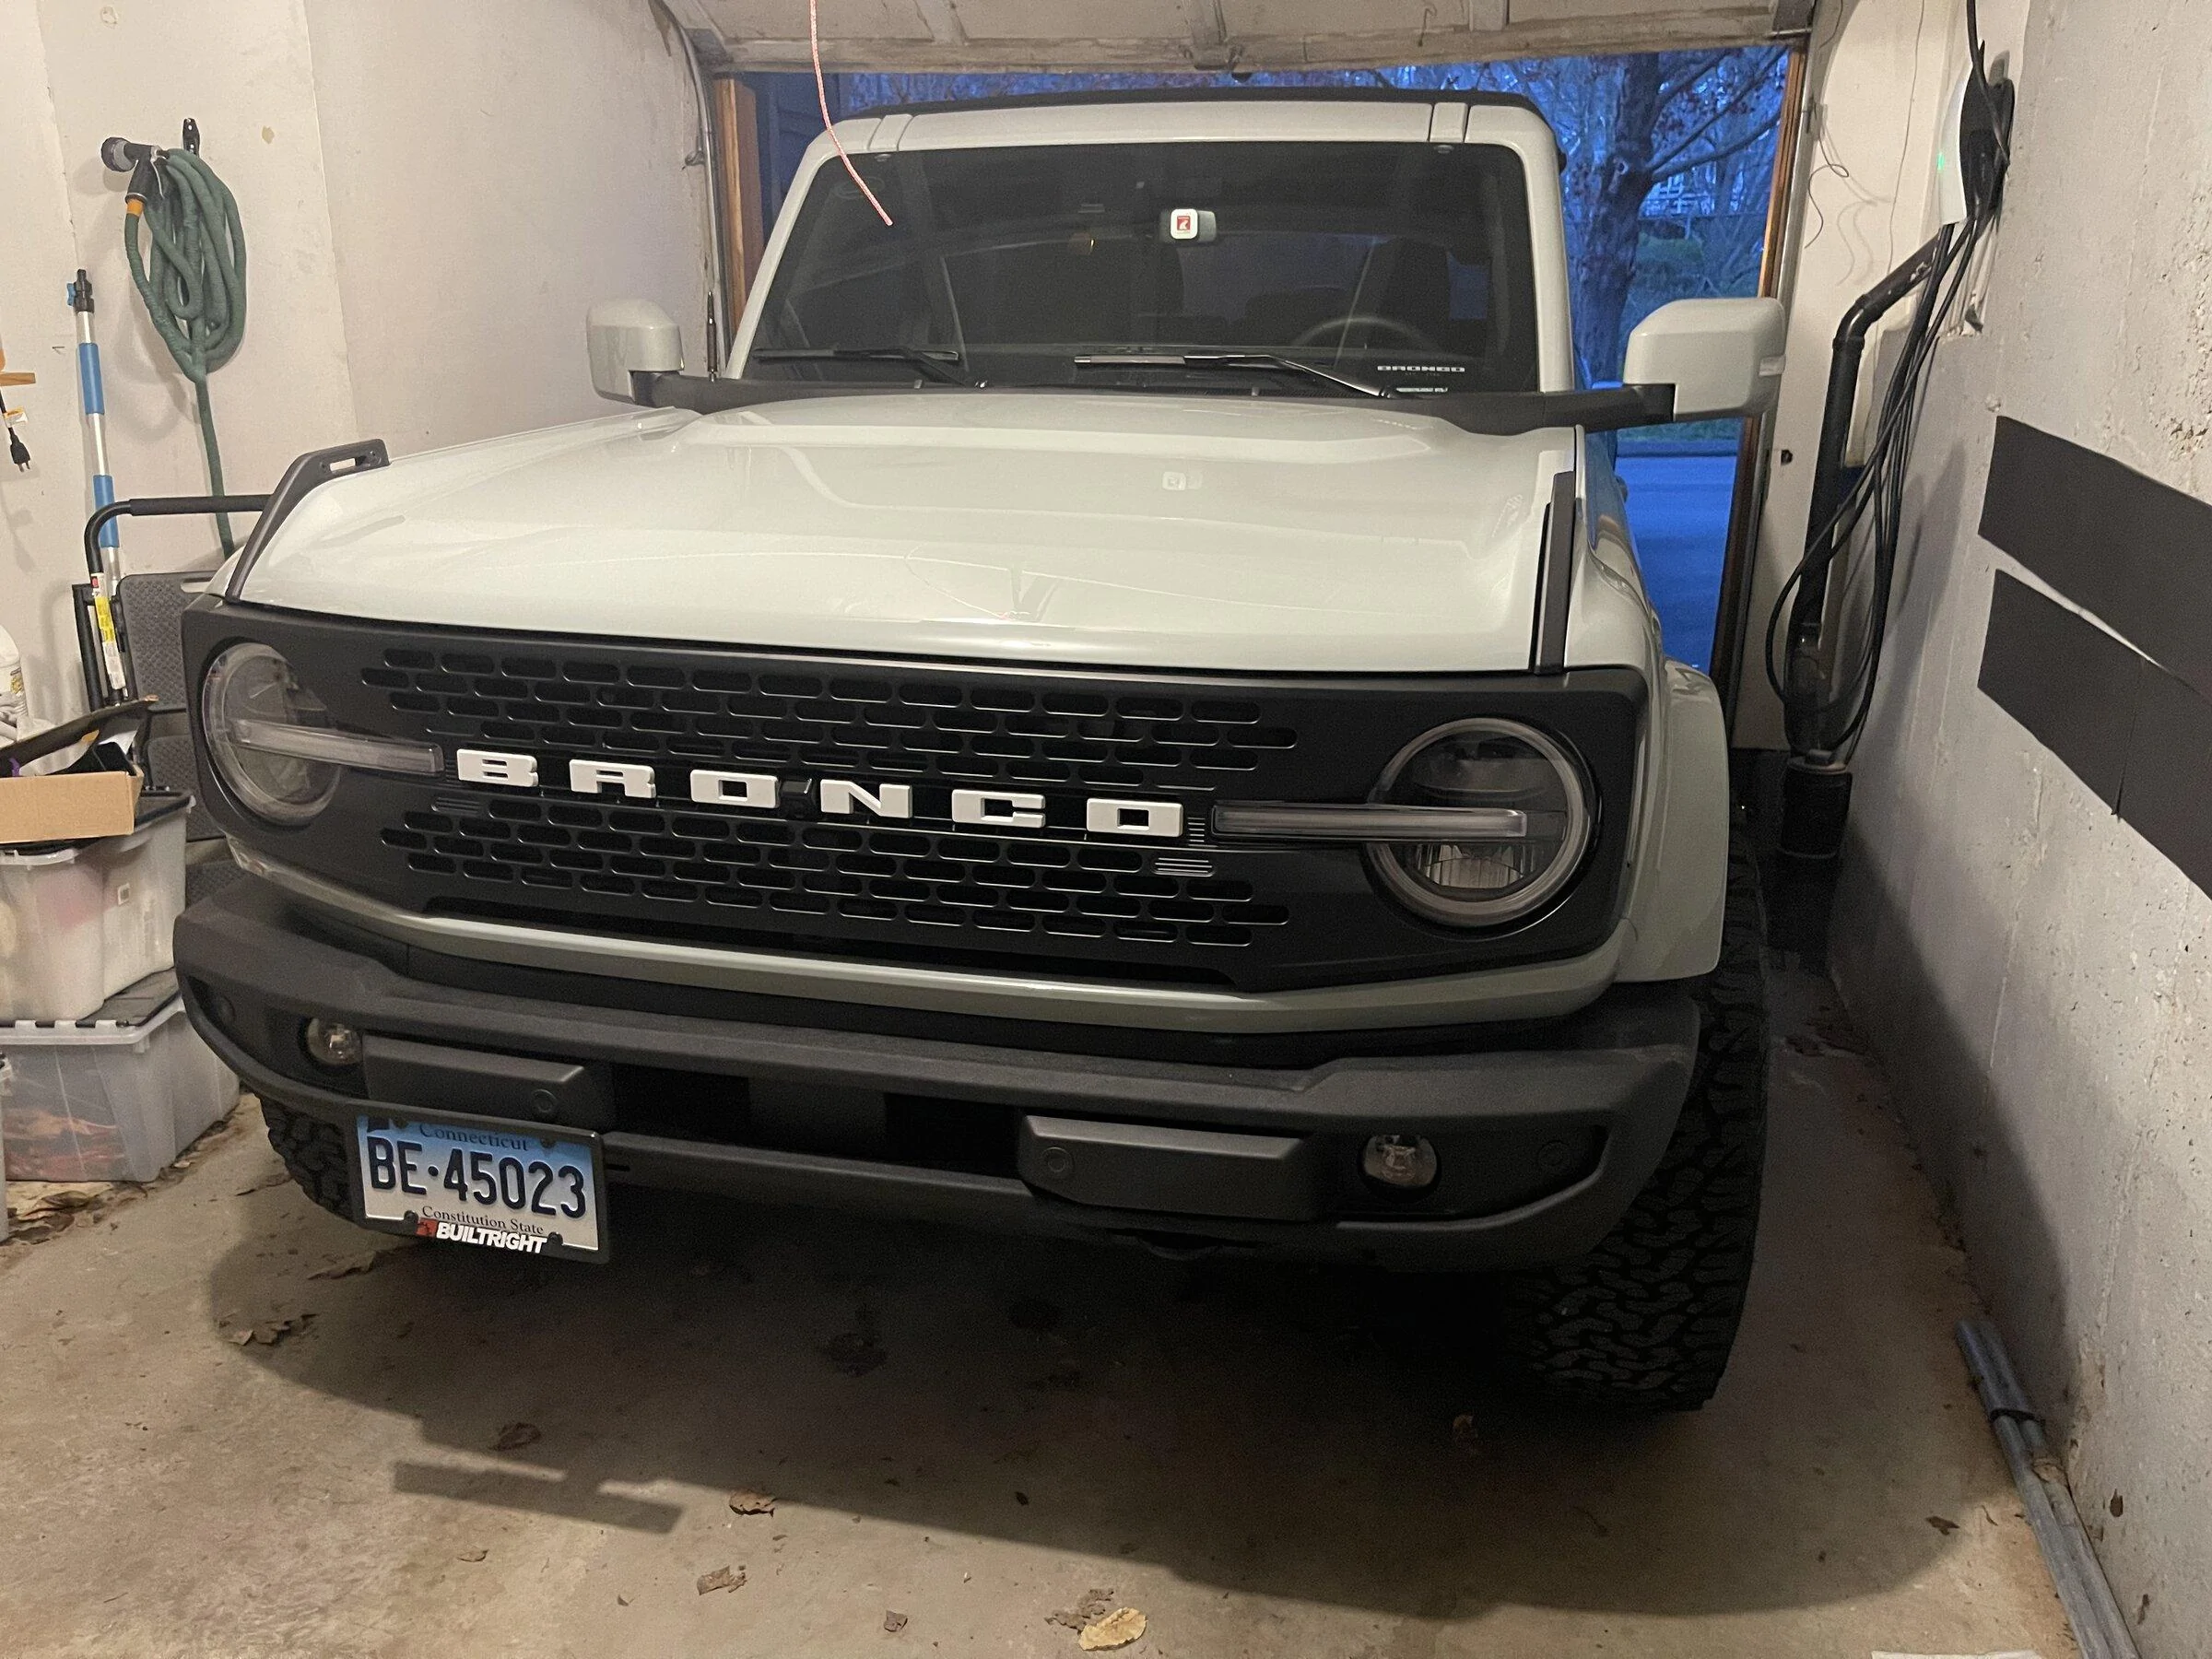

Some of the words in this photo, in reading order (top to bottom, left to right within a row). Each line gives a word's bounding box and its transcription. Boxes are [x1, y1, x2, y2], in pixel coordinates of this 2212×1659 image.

[456, 748, 1183, 837] BRONCO
[419, 1123, 527, 1151] Connecticut
[422, 1206, 506, 1228] Constitution
[510, 1219, 544, 1234] State
[436, 1221, 547, 1253] BUILTRIGHT
